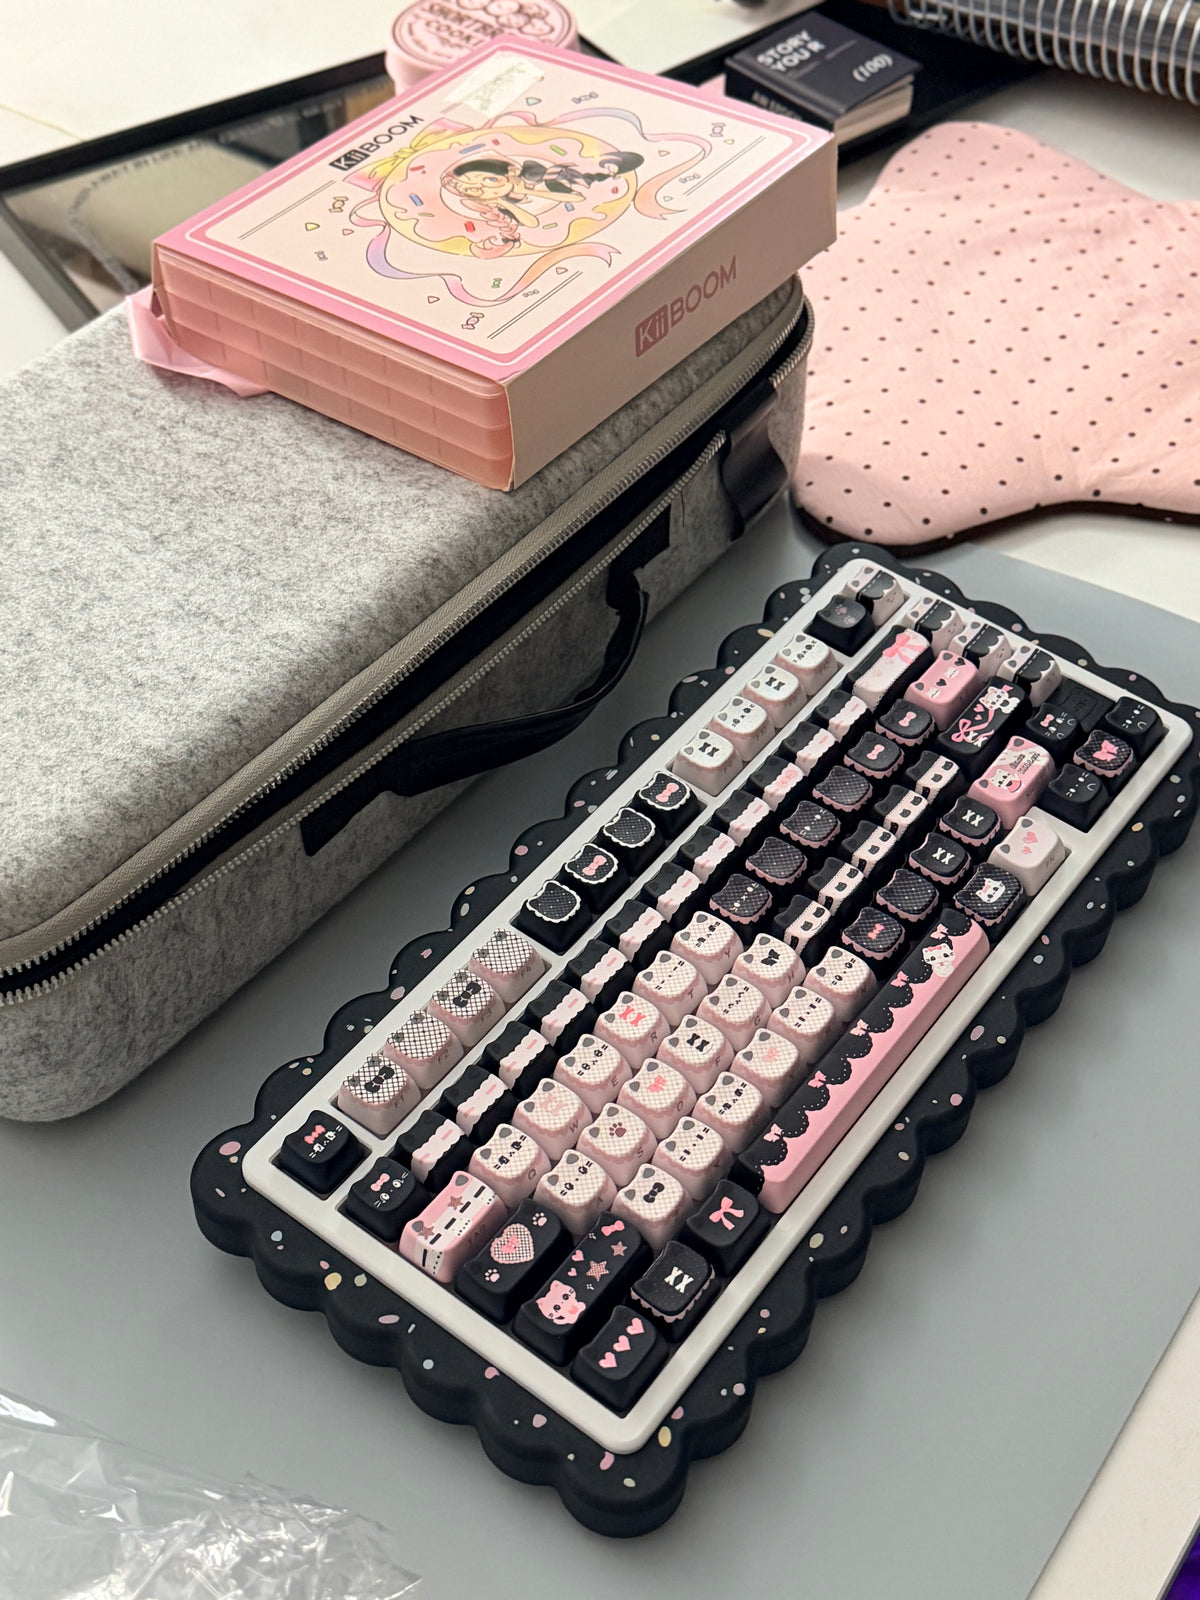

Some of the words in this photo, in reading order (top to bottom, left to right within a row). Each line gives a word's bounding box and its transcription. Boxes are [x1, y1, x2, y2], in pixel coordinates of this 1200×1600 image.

[756, 30, 812, 66] STORY
[853, 54, 894, 82] (100)
[329, 115, 424, 171] KiiBOOM
[635, 254, 737, 358] KiiBOOM
